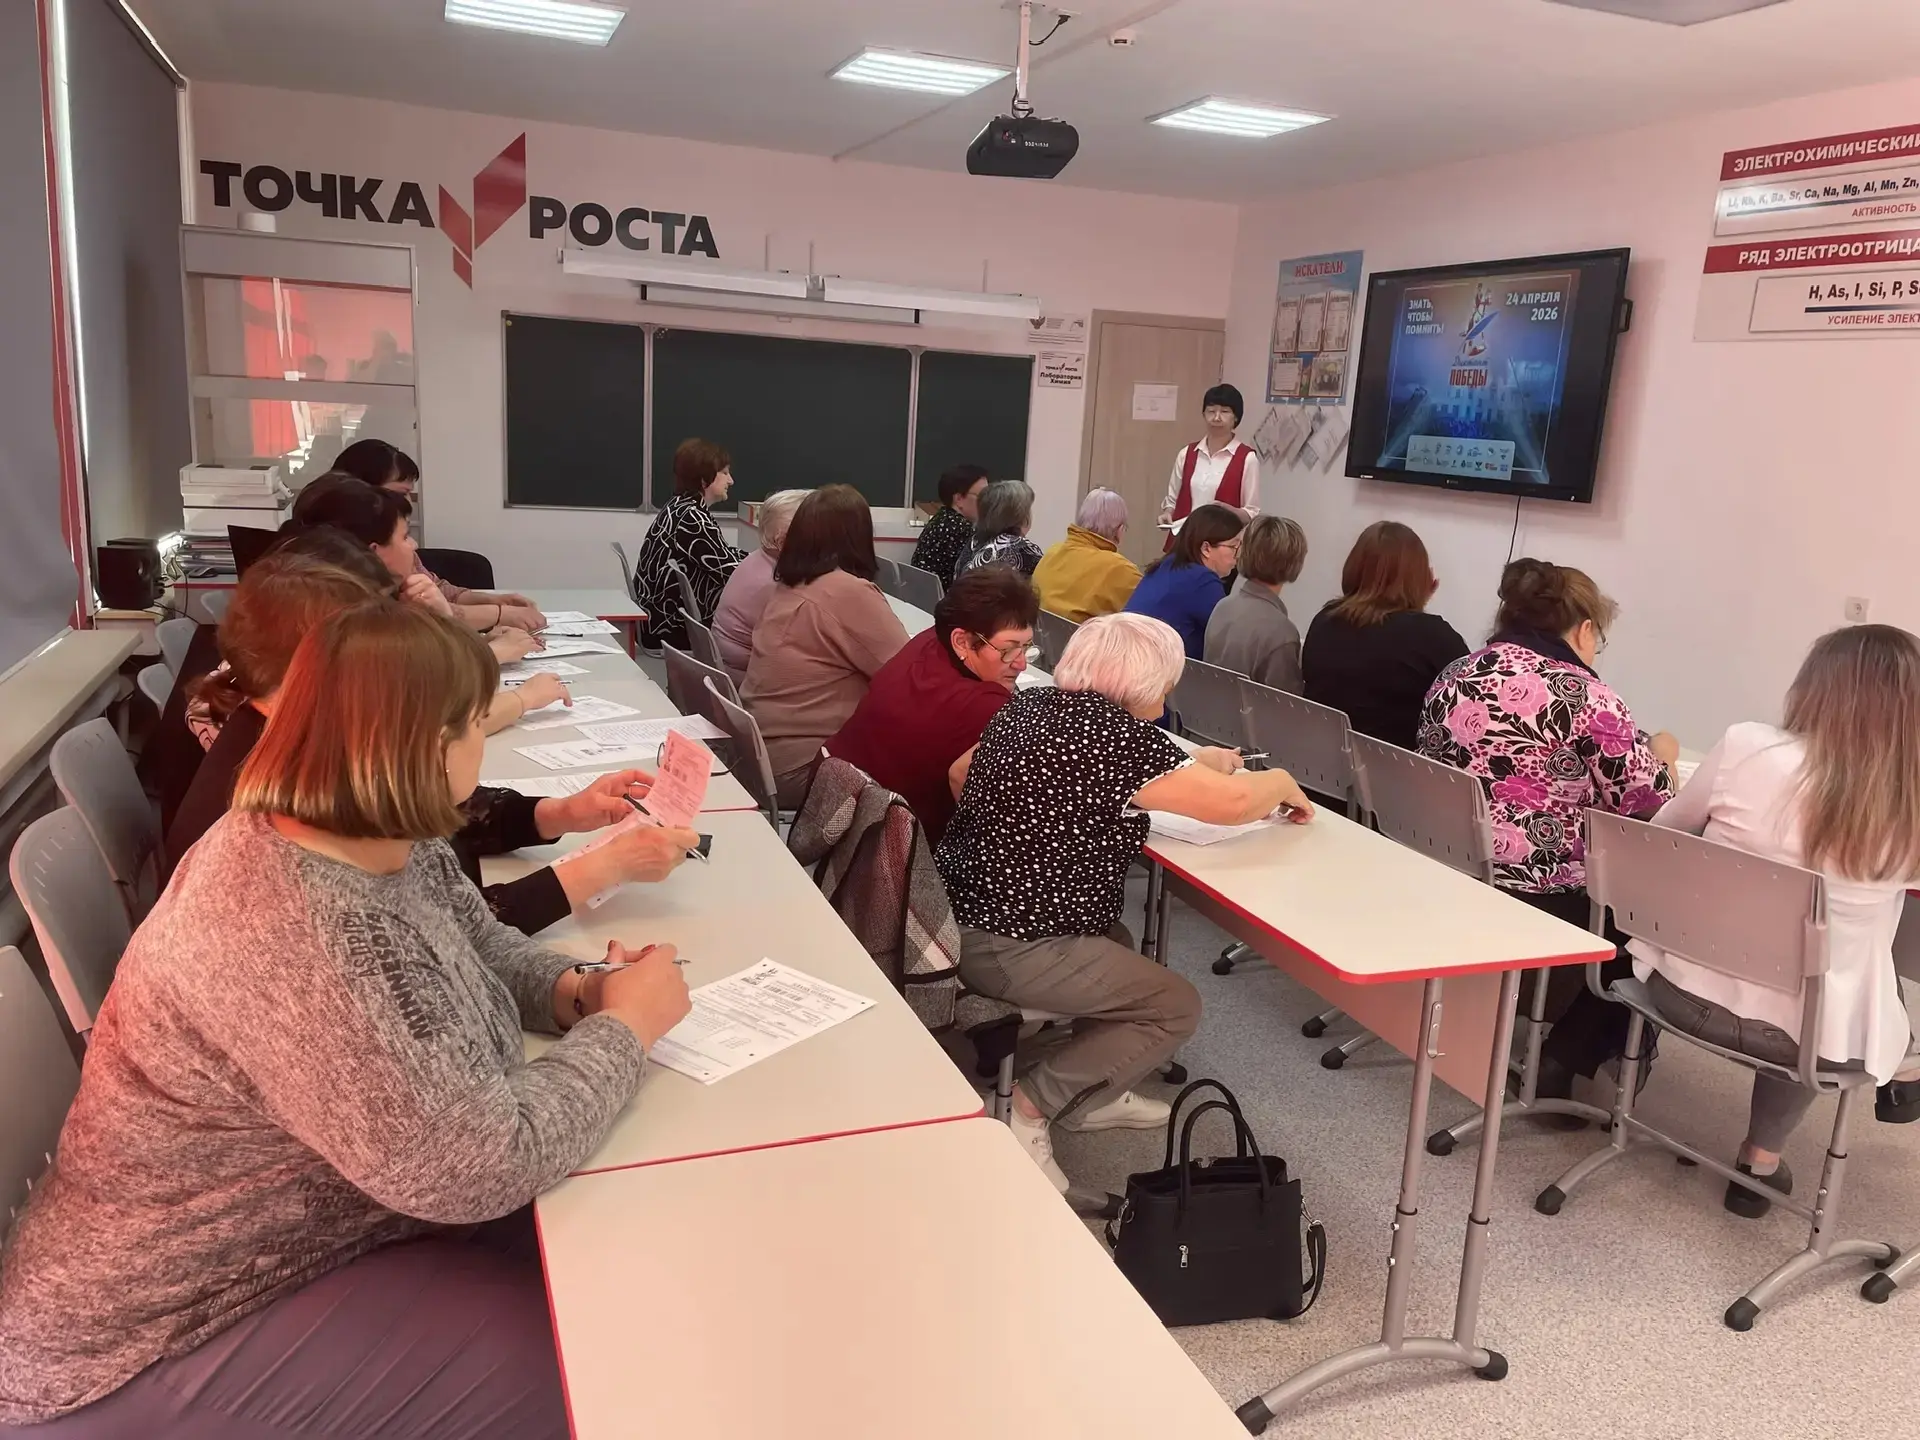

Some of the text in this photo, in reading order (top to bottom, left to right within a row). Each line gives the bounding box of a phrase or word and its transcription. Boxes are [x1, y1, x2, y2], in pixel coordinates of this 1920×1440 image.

[1789, 190, 1801, 201] Sr,
[1804, 188, 1820, 200] Ca,
[1823, 186, 1840, 198] Na,
[1842, 183, 1860, 196] Mg,
[1863, 181, 1877, 194] Al,
[1880, 179, 1899, 191] Mn,
[1902, 176, 1919, 189] Zn,
[200, 159, 720, 258] ТОЧКА РОСТА
[1851, 202, 1917, 217] АКТИВНОСТЬ
[1738, 249, 1770, 265] РЯД
[1295, 260, 1344, 278] ИСКАТЕЛИ
[1505, 291, 1561, 306] 24 АПРЕЛЯ
[1809, 285, 1822, 301] H,
[1827, 283, 1849, 301] As,
[1868, 281, 1887, 300] Si,
[1892, 280, 1904, 299] P,
[1909, 280, 1920, 295] S
[1407, 311, 1434, 322] ЧТОБЫ
[1530, 306, 1558, 321] 2026
[1827, 313, 1885, 325] УСИЛЕНИЕ
[1405, 323, 1445, 335] ПОМНИТЬ!
[1449, 368, 1488, 389] ПОБЕДЫ
[365, 912, 433, 1040] MINNESOTA
